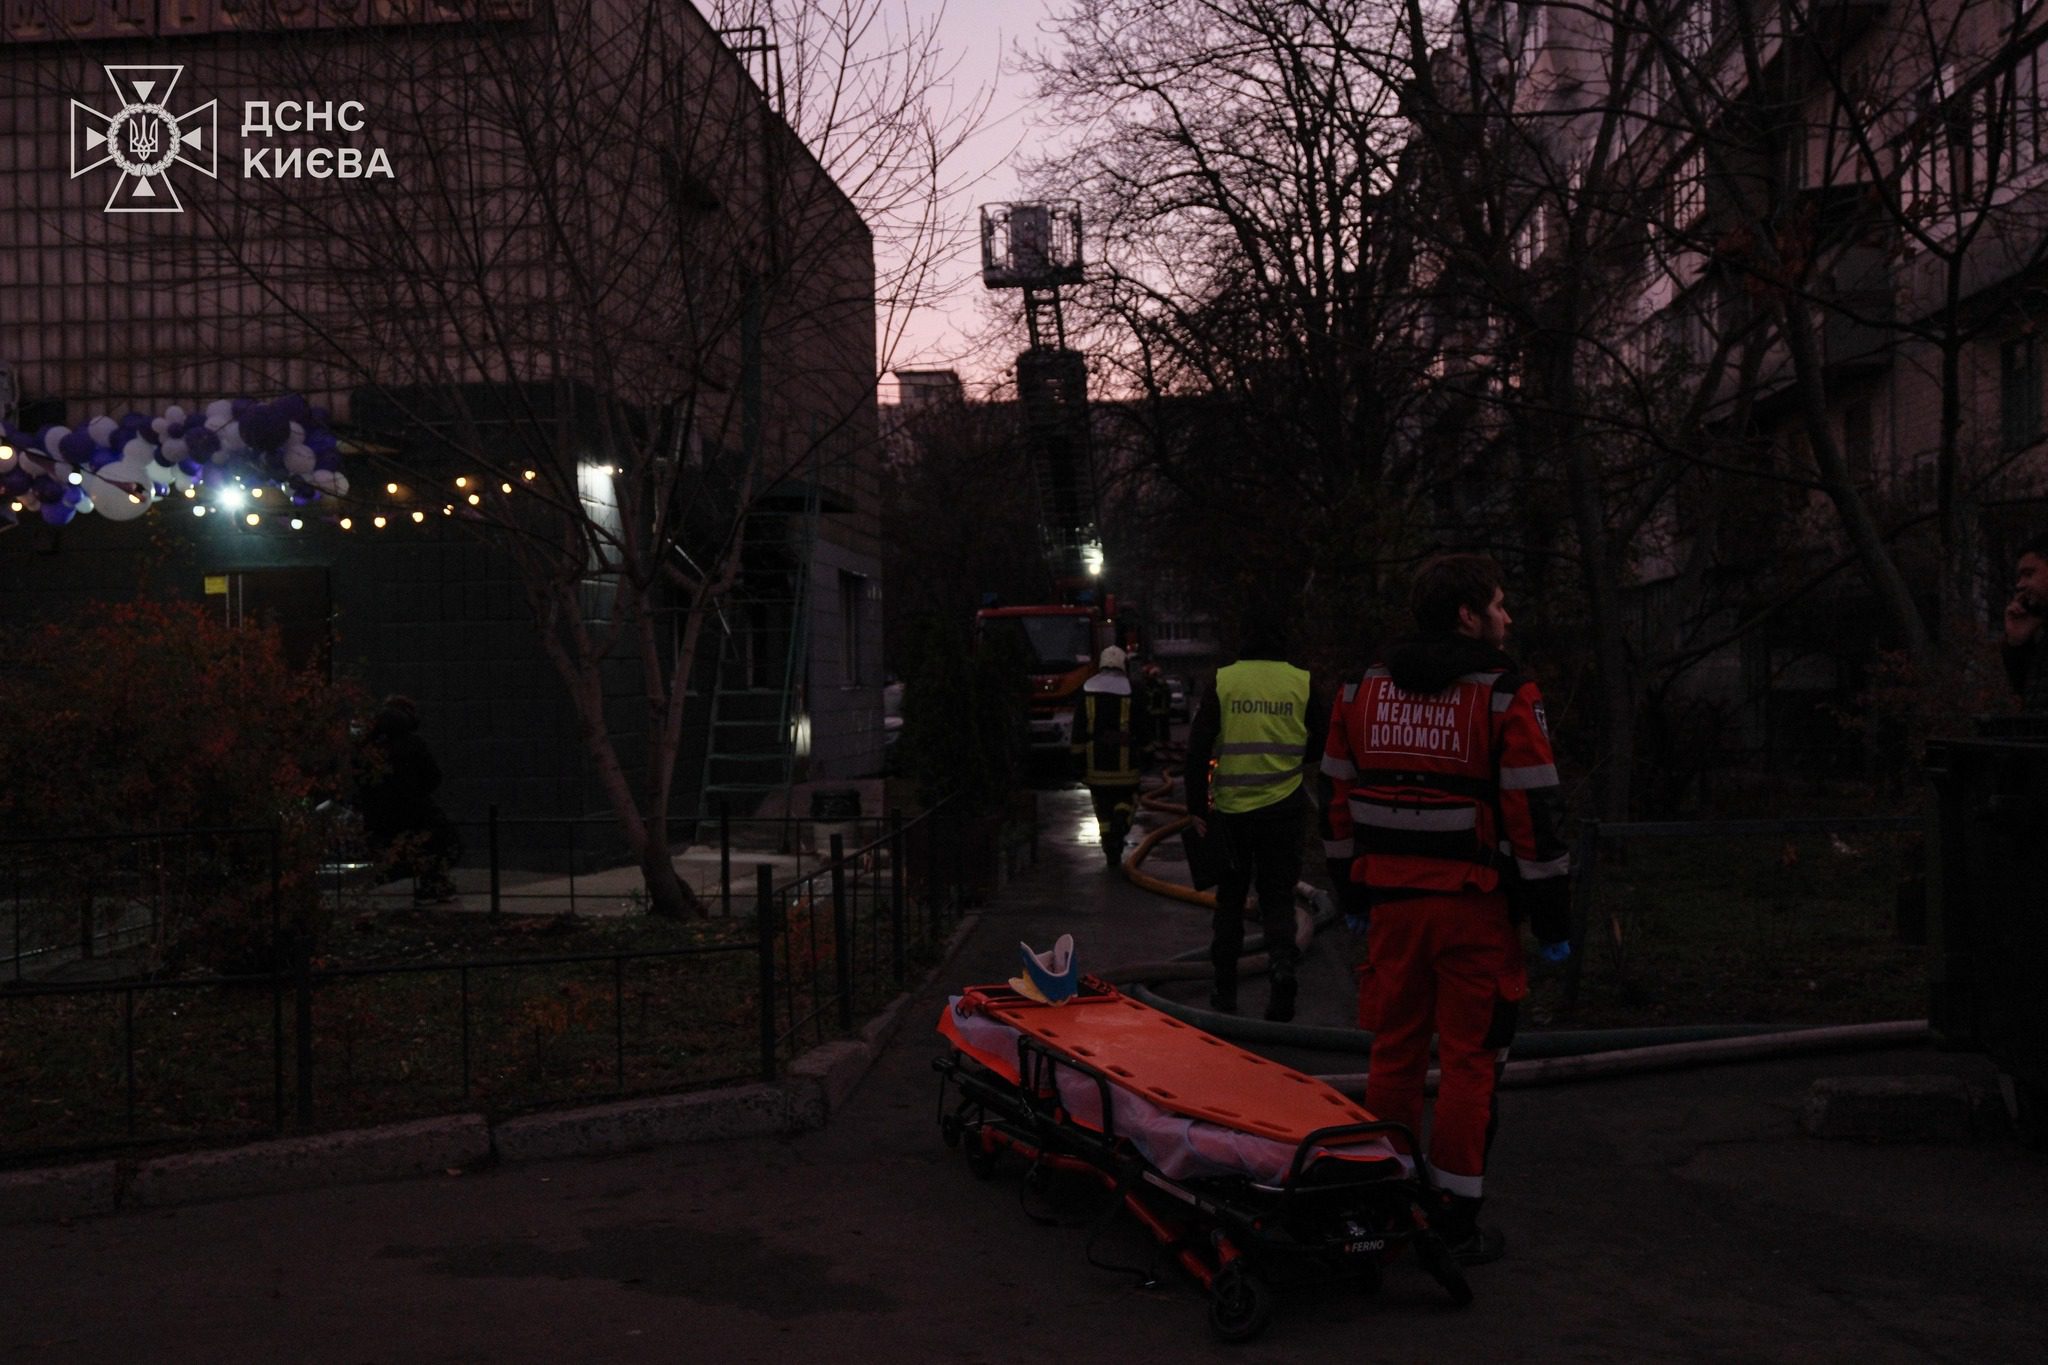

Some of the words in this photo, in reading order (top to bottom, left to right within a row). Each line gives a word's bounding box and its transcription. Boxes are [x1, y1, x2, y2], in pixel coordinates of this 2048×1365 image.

[1231, 700, 1293, 716] ПОЛІЦІЯ
[1376, 702, 1455, 728] МЕДИЧНА
[1371, 724, 1461, 752] ДОПОМОГА
[1351, 1239, 1385, 1253] FERNO
